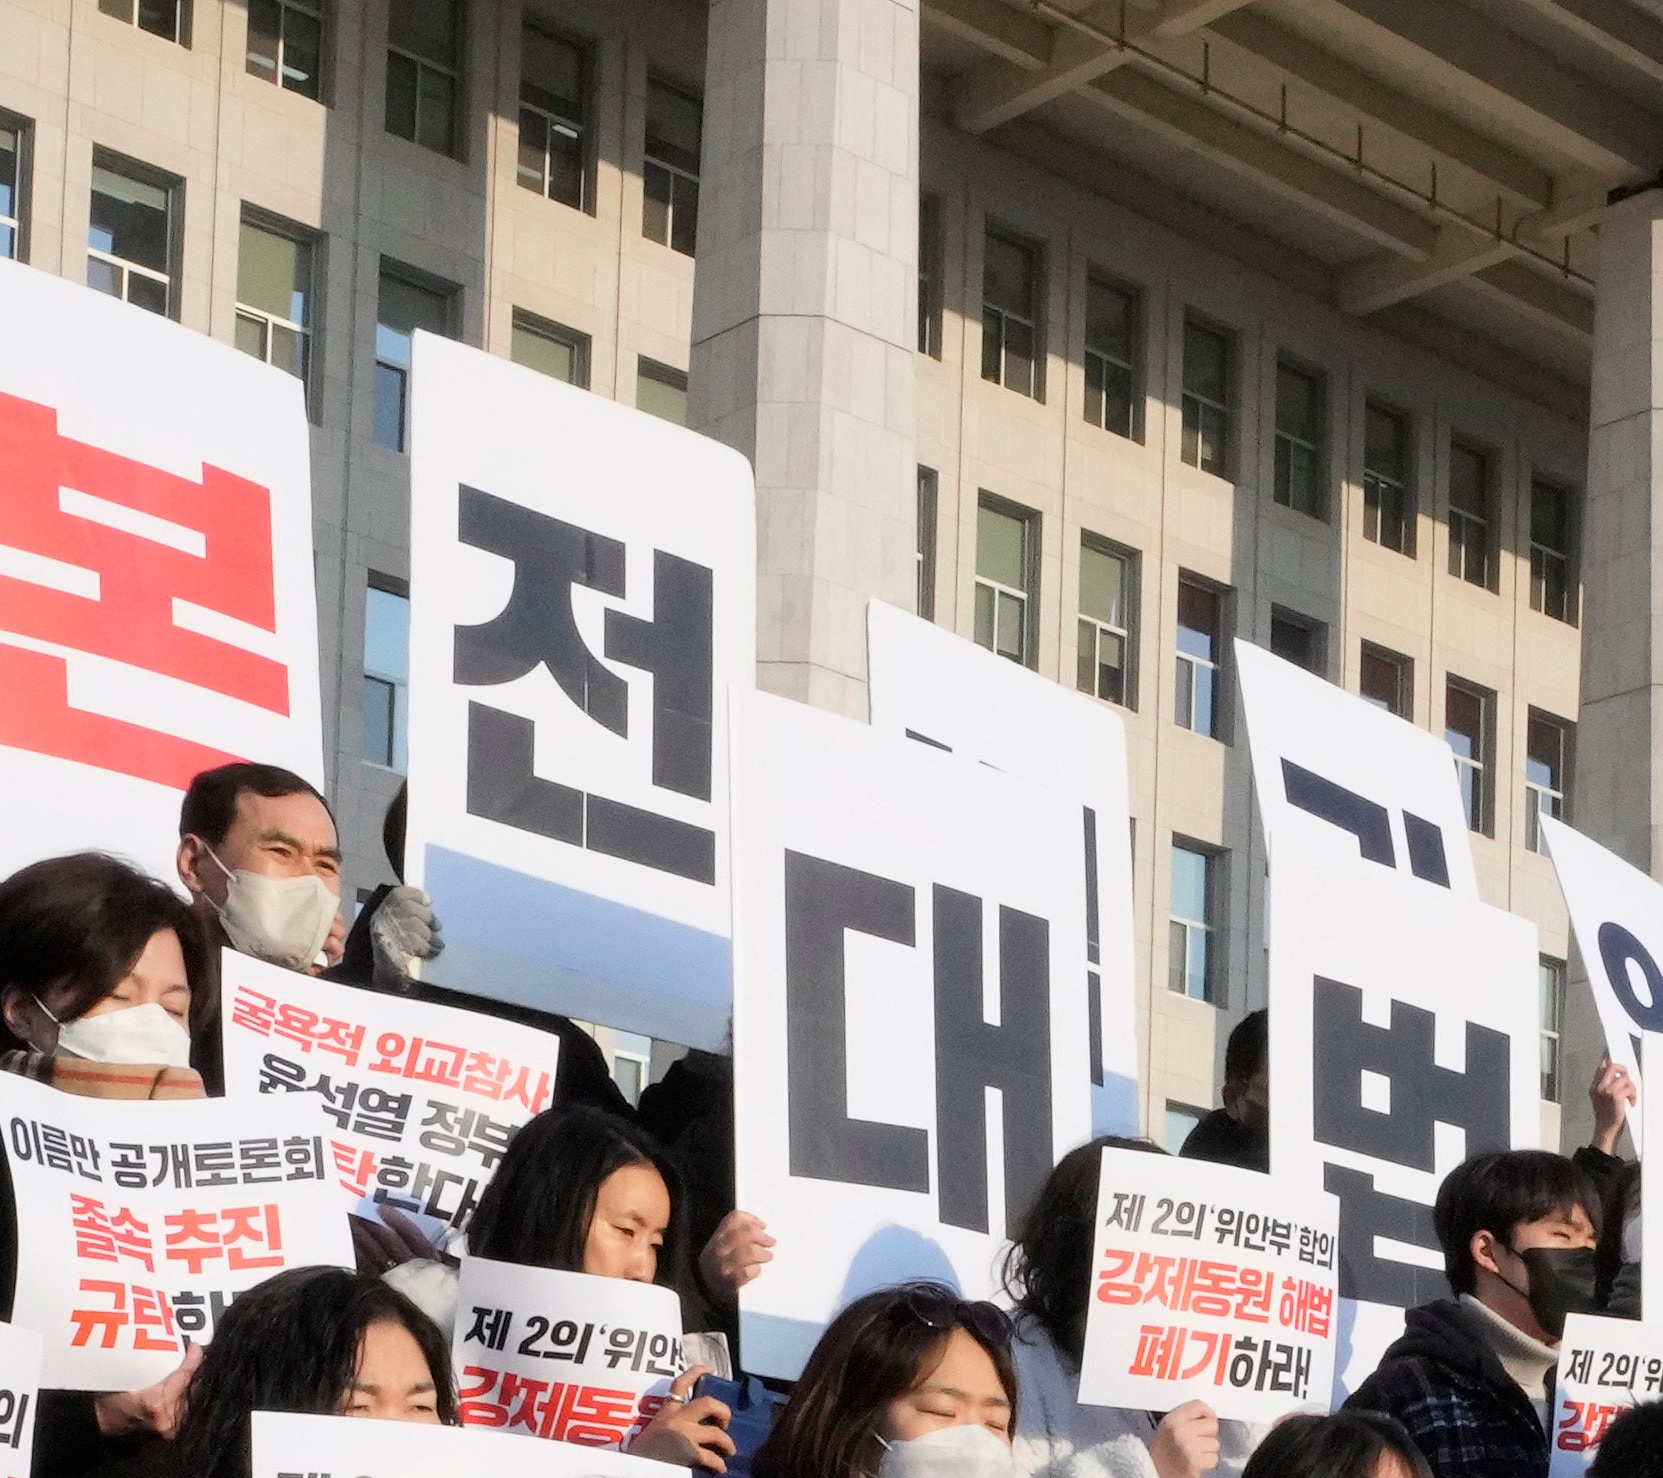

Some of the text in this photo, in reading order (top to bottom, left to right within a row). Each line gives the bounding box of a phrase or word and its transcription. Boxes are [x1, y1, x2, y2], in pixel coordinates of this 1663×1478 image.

[453, 481, 716, 888] 전
[232, 984, 551, 1116] 굴욕적 외교참사
[782, 847, 1055, 1236] 대
[11, 1117, 326, 1190] 이름만 공개토론회
[419, 1106, 522, 1169] 정부
[1311, 975, 1511, 1310] 법
[69, 1192, 284, 1275] 졸속 추진
[1105, 1192, 1145, 1232] 제
[465, 1305, 511, 1351] 제
[1096, 1249, 1333, 1340] 강제동원 해법
[1128, 1325, 1312, 1400] 폐기하라!
